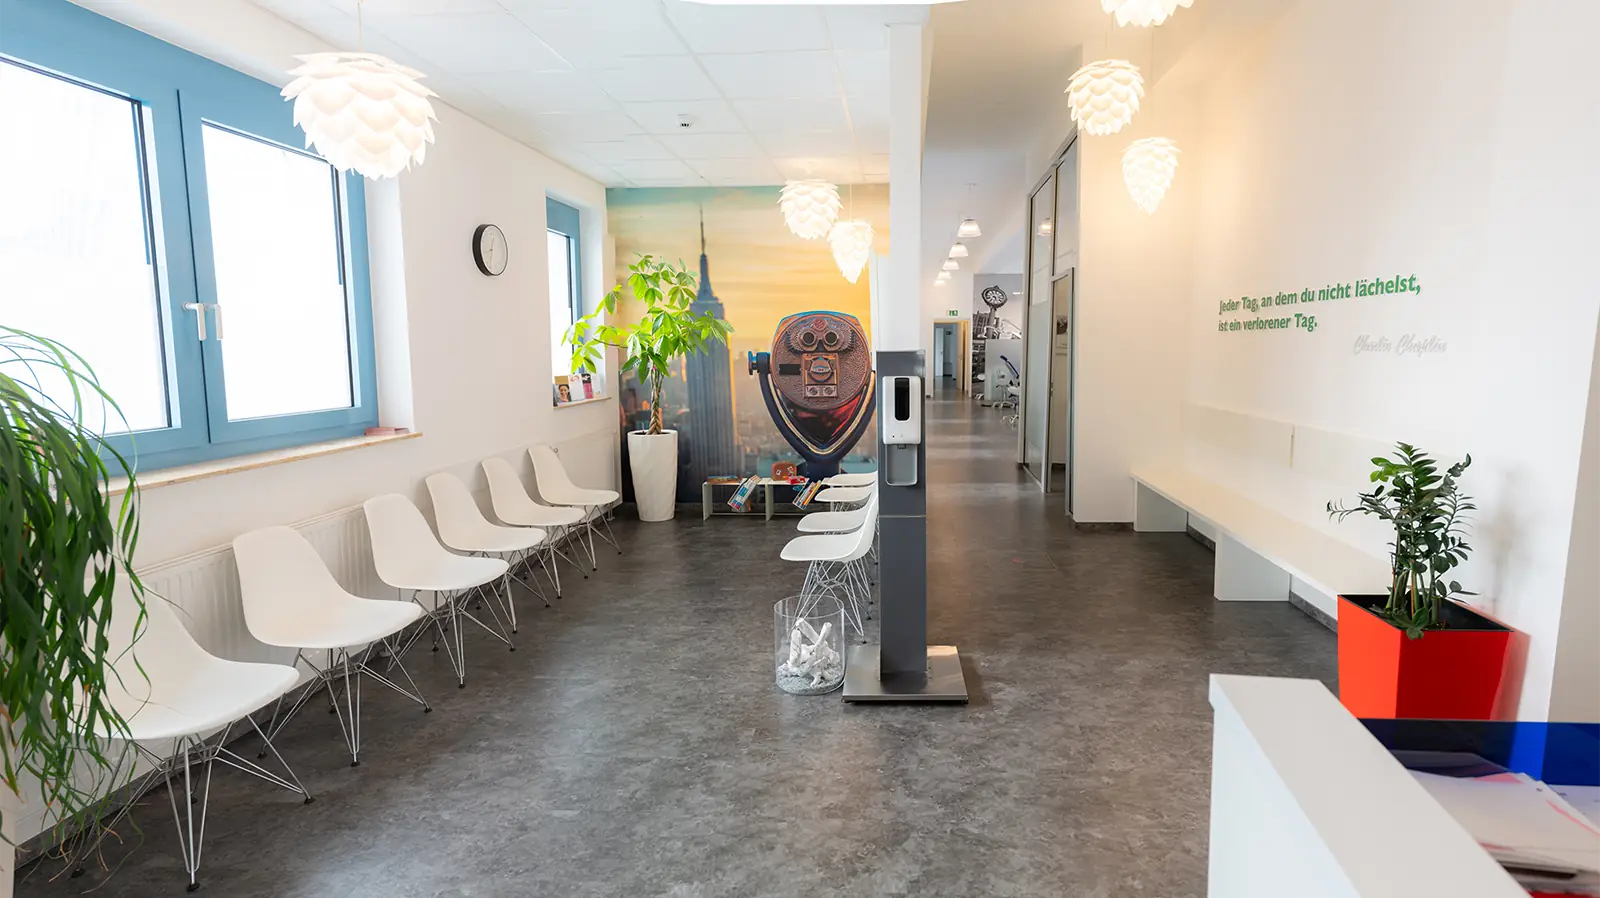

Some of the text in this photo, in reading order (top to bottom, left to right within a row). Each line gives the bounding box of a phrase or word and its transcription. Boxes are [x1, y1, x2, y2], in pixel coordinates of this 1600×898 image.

[1219, 274, 1421, 315] Jeder Tag, an dem du nicht lächelst,
[1218, 313, 1318, 332] ist ein verlorener Tag.
